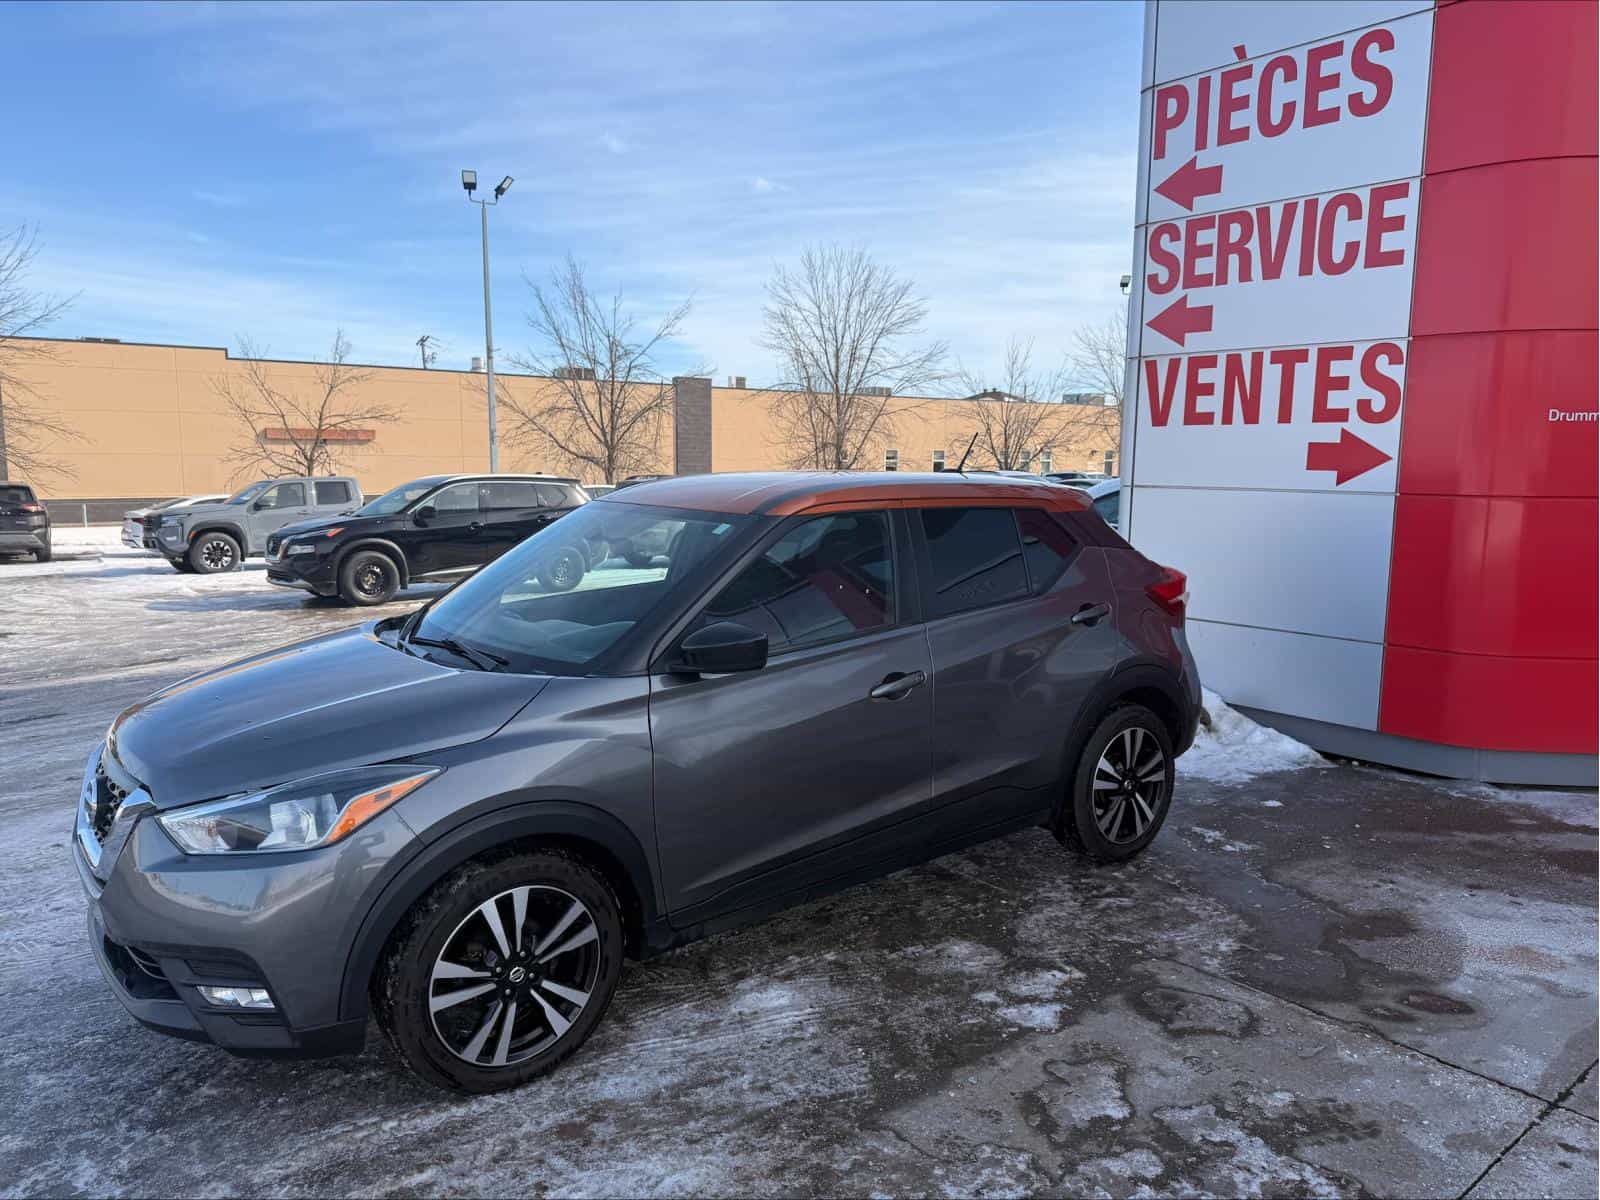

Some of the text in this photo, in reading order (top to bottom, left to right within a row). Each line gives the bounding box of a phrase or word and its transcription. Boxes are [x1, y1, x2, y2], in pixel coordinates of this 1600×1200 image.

[1154, 28, 1395, 160] PIÈCES
[1147, 182, 1410, 295] SERVICE
[1144, 342, 1405, 428] VENTES
